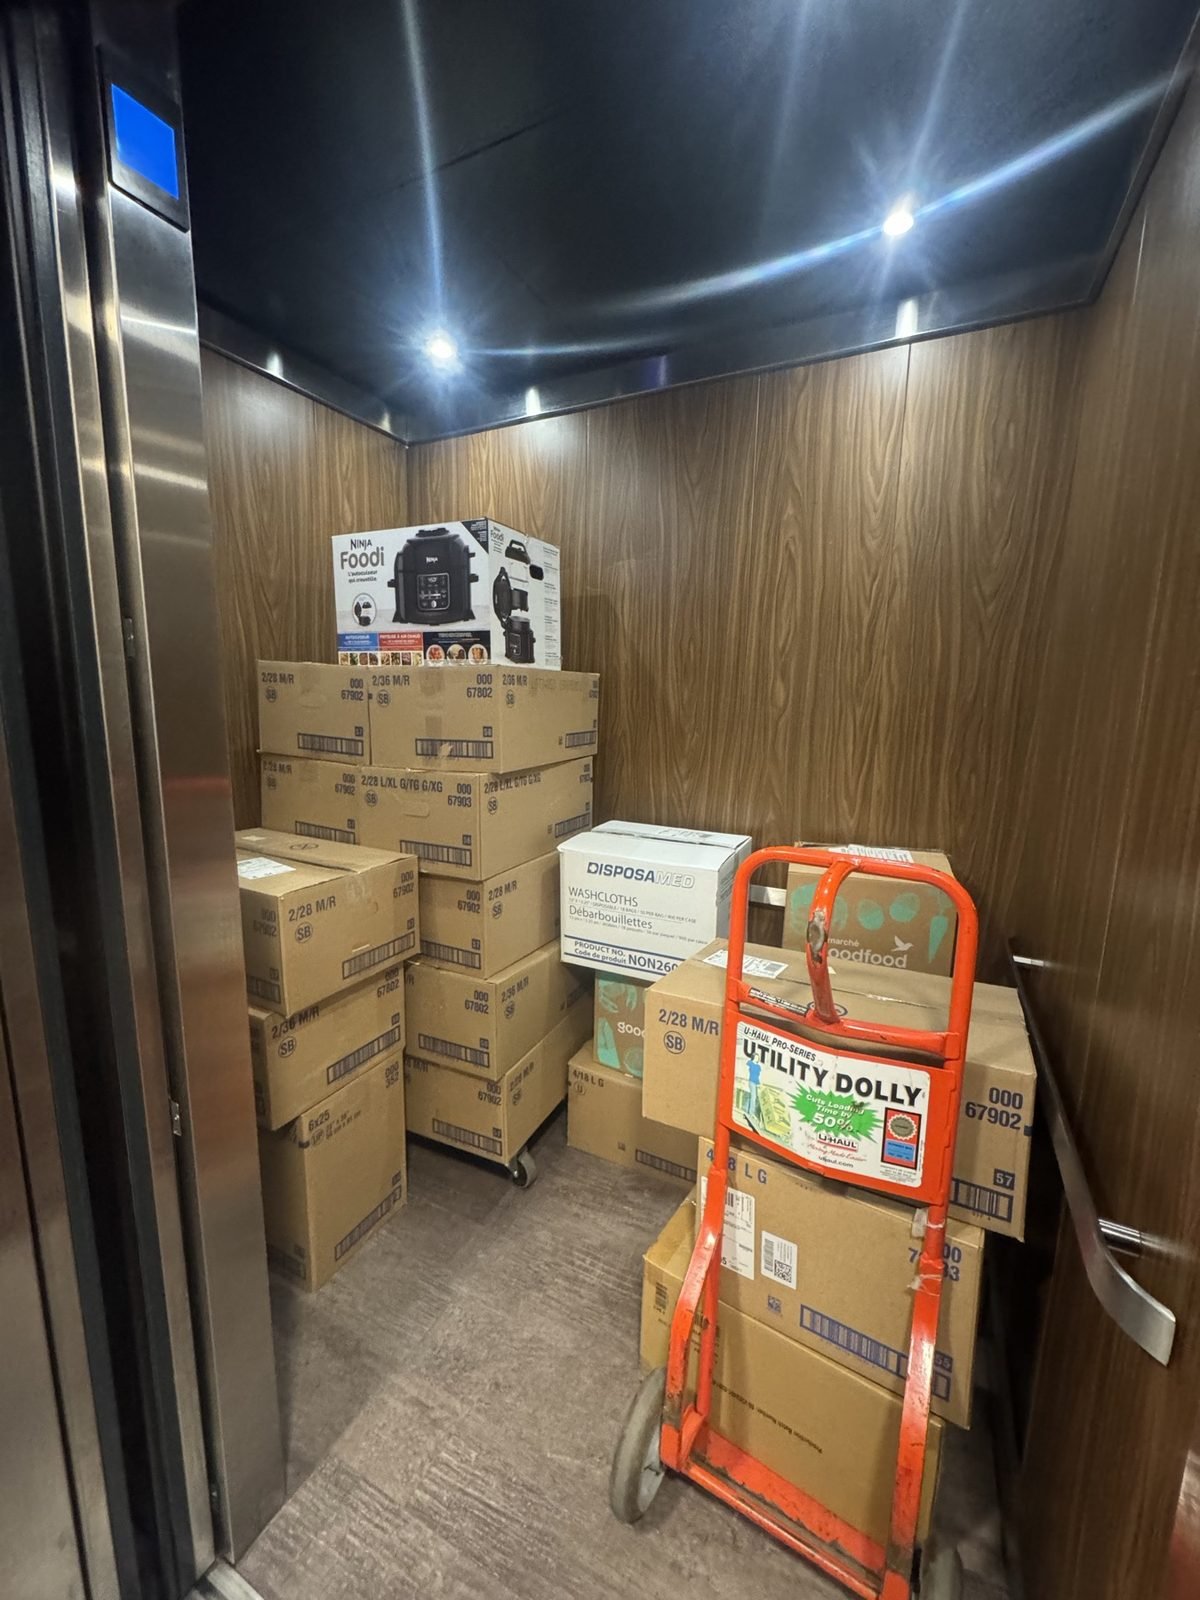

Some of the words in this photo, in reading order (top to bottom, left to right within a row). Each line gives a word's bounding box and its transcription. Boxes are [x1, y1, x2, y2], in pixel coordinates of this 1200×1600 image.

[350, 538, 373, 551] NINJA
[340, 545, 385, 570] Foodi
[261, 672, 278, 683] 2/28
[280, 673, 294, 684] M/R
[350, 678, 363, 689] 000
[372, 675, 390, 686] 2/36
[393, 675, 410, 686] M/R
[476, 674, 492, 685] 000
[341, 689, 363, 701] 67902
[467, 687, 492, 698] 67802
[343, 773, 355, 784] 000
[361, 775, 378, 786] 2/28
[381, 777, 397, 789] L/XL
[400, 779, 419, 790] G/TG
[422, 780, 443, 792] G/XG
[457, 783, 472, 795] 000
[448, 795, 472, 807] 67903
[401, 871, 414, 883] 000
[586, 861, 695, 889] DISPOSAMED
[393, 882, 414, 898] 67902
[466, 889, 480, 901] 000
[504, 880, 517, 895] M/R
[569, 887, 638, 907] WASHCLOTHS
[288, 903, 312, 922] 2/28
[316, 896, 337, 912] M/R
[457, 900, 481, 913] 67902
[569, 905, 653, 929] Débarbouillettes
[574, 940, 610, 954] PRODUCT
[612, 948, 626, 957] NO.
[828, 938, 860, 948] marché
[574, 948, 591, 957] Code
[592, 951, 601, 959] de
[602, 953, 627, 964] produit
[828, 947, 907, 968] oodfood
[377, 979, 399, 998] 67802
[474, 990, 489, 1002] 000
[272, 1017, 296, 1039] 2/36
[299, 1006, 320, 1024] M/R
[658, 1009, 687, 1028] 2/28
[691, 1017, 719, 1036] M/R
[666, 1034, 683, 1051] SB
[744, 1026, 770, 1043] U-HAUL
[772, 1037, 816, 1062] PRO-SERIES
[572, 1069, 589, 1082] 4/18
[591, 1075, 596, 1085] L
[599, 1078, 605, 1088] G
[743, 1039, 829, 1087] UTILITY
[836, 1073, 922, 1106] DOLLY
[806, 1094, 826, 1106] Cuts
[989, 1087, 1023, 1109] 000
[816, 1105, 838, 1116] Time
[840, 1110, 852, 1118] by
[965, 1102, 1022, 1130] 67902
[308, 1109, 330, 1132] 6x25
[812, 1112, 854, 1132] 50%
[745, 1163, 752, 1179] L
[758, 1168, 767, 1184] G
[995, 1171, 1013, 1187] 57
